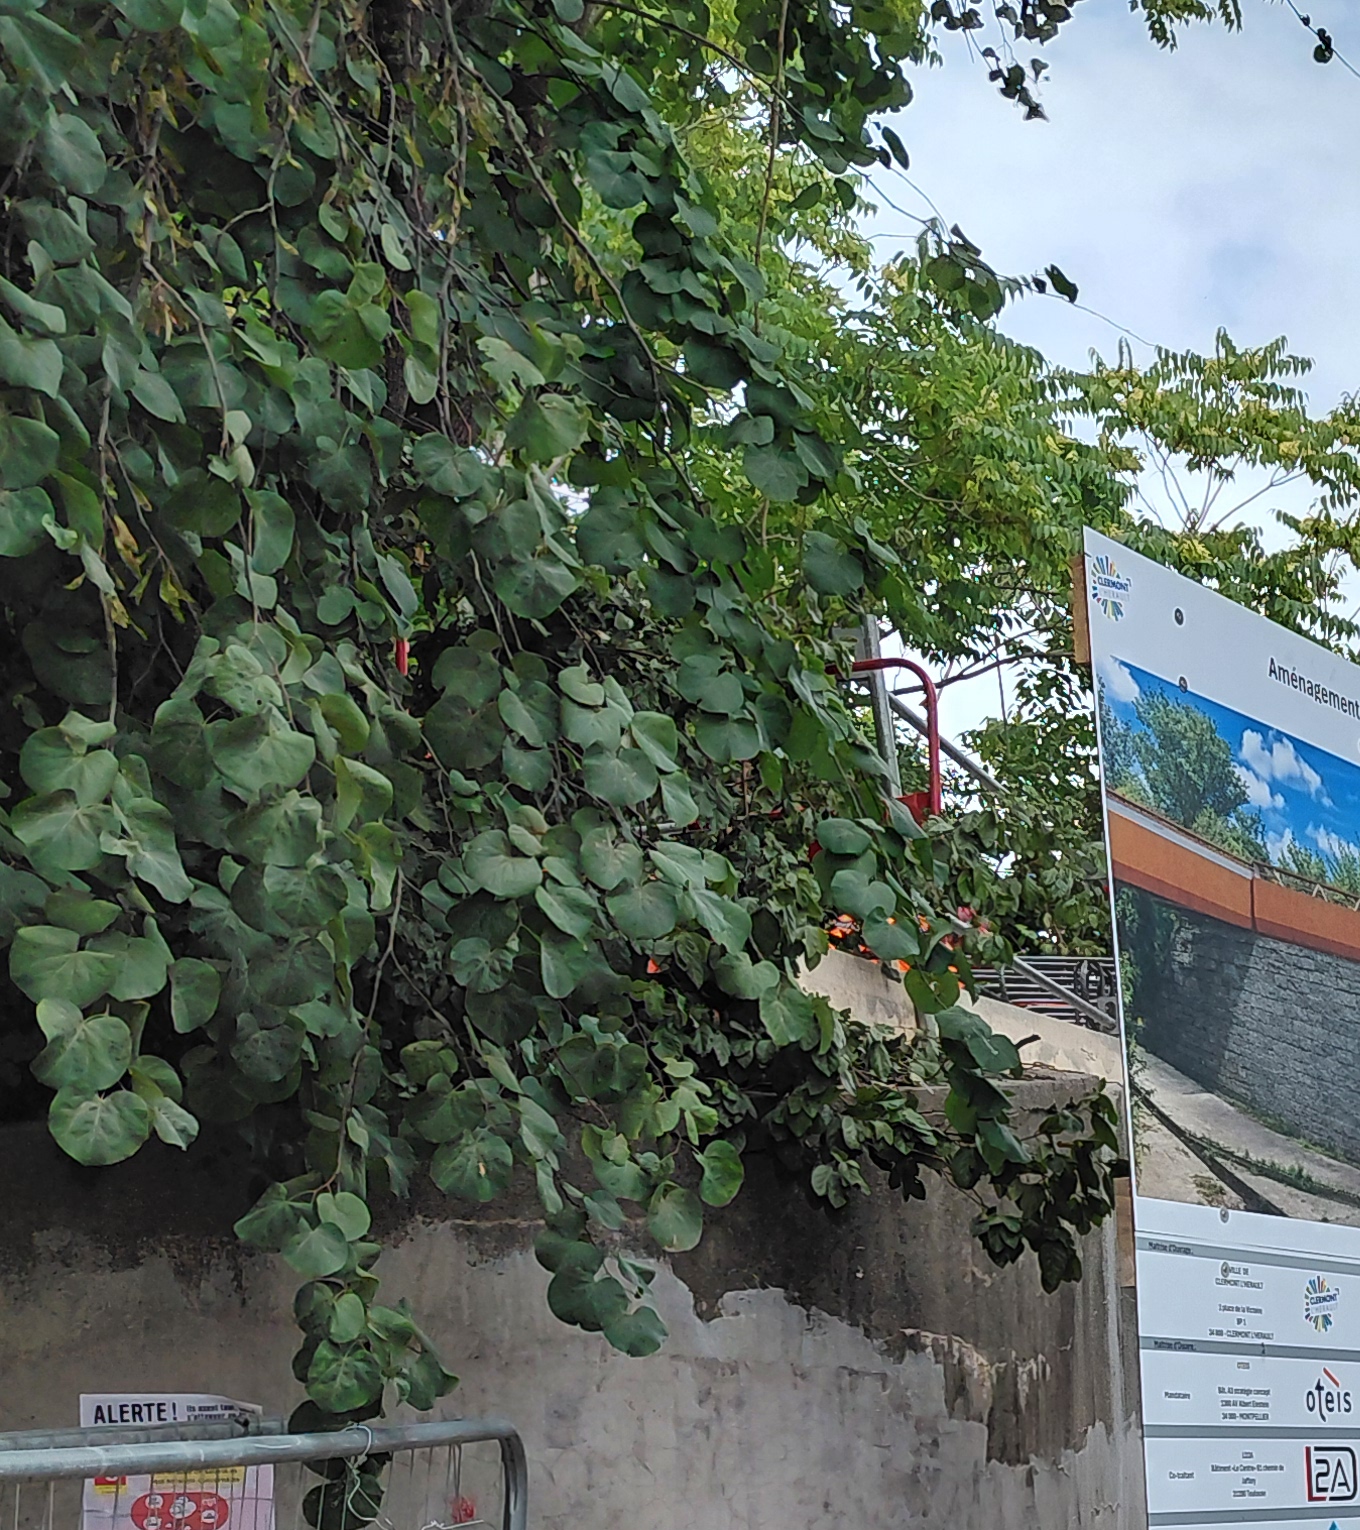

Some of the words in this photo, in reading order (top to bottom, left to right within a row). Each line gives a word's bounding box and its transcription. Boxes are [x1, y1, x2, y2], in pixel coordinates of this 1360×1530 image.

[1097, 576, 1129, 592] CLERMONT
[1268, 656, 1360, 718] Aménagement
[1309, 1293, 1338, 1305] CLERMONT
[1305, 1367, 1352, 1423] oteis
[94, 1402, 168, 1424] ALERTE
[171, 1402, 178, 1421] !
